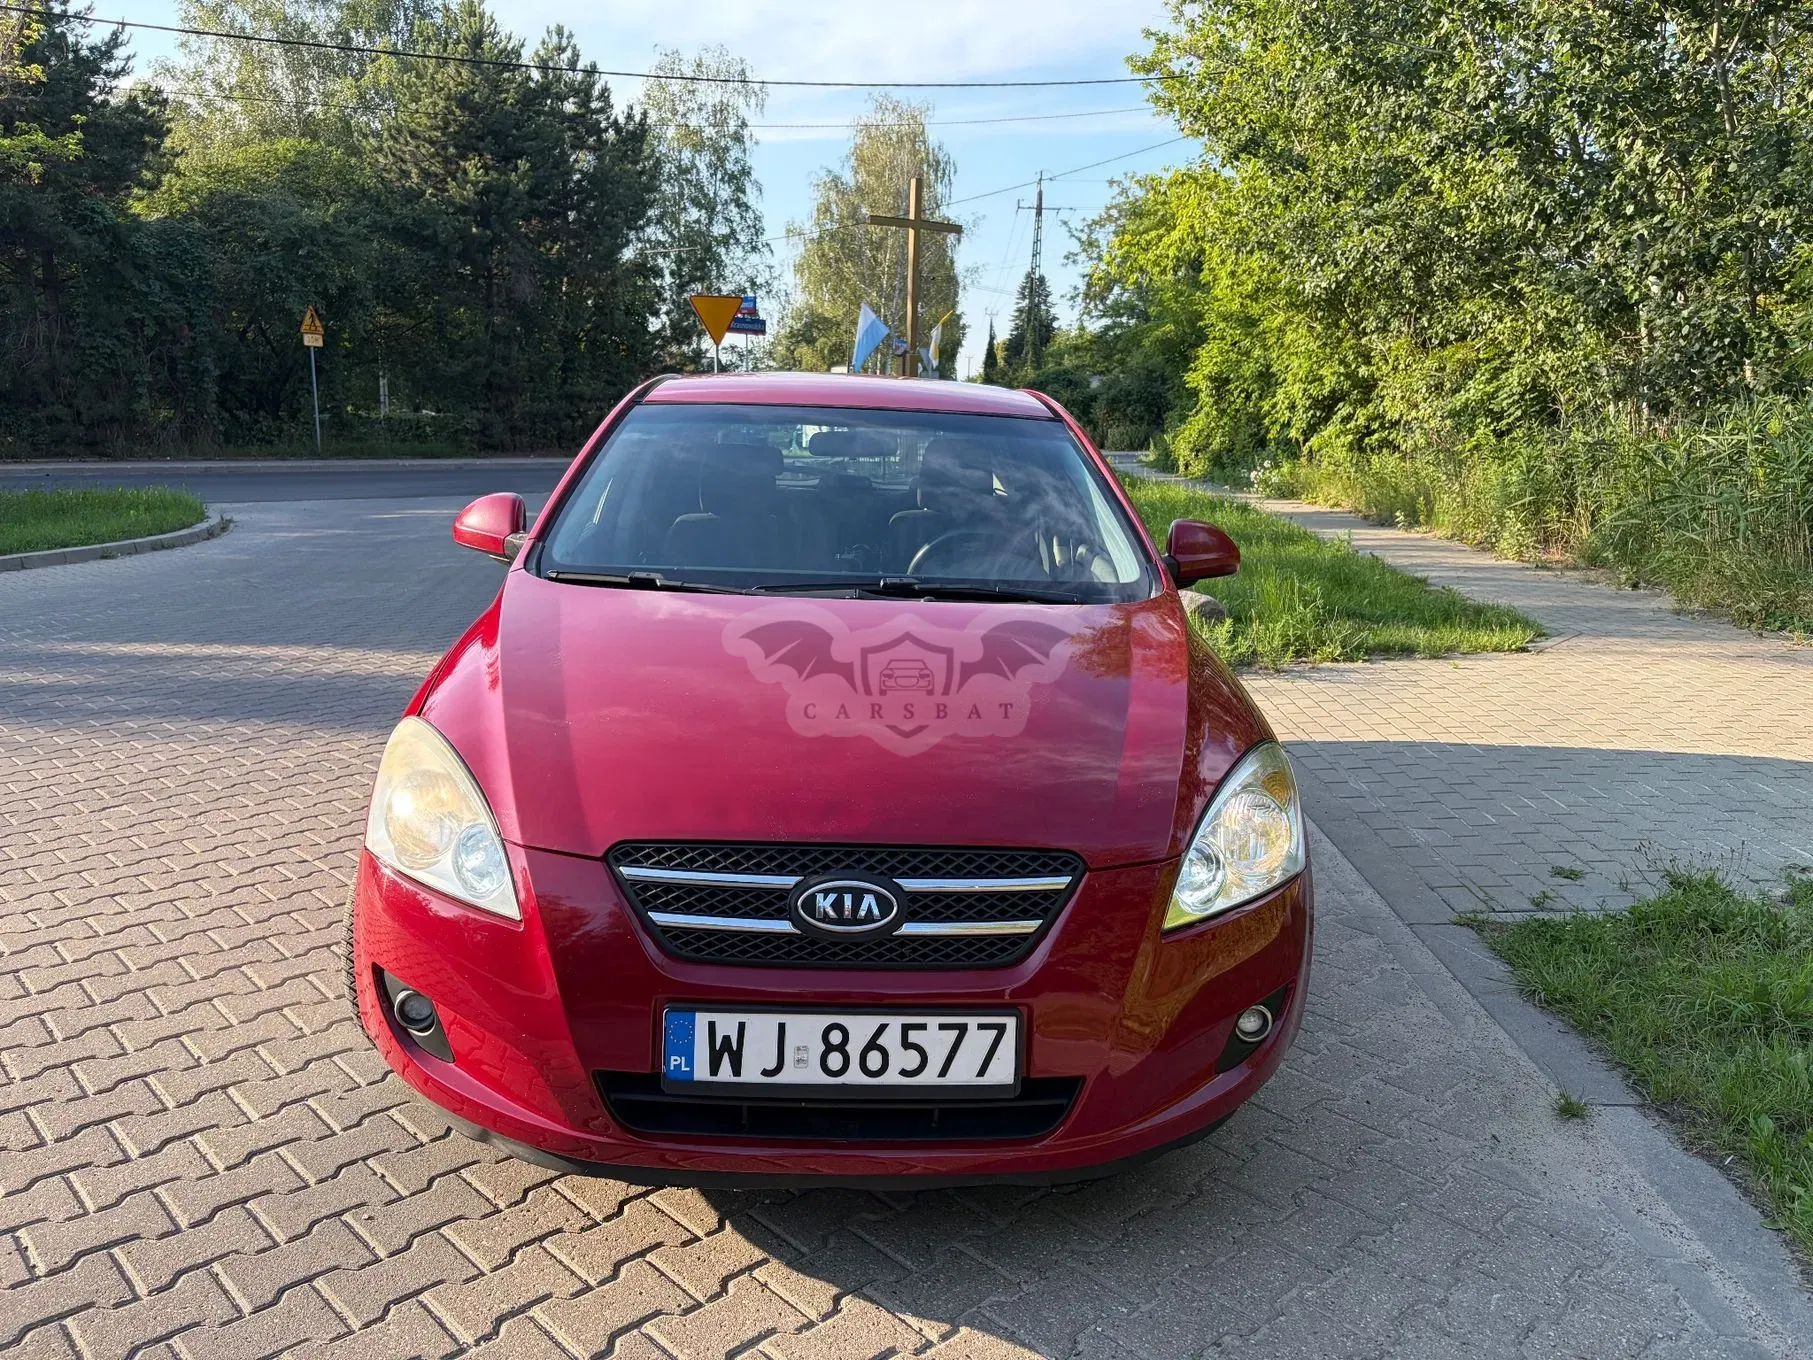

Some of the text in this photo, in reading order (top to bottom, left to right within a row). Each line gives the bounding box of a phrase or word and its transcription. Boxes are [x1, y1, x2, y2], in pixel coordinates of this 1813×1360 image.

[814, 892, 882, 920] KIA
[669, 1055, 691, 1072] PL
[707, 1020, 1008, 1079] WJ 86577
